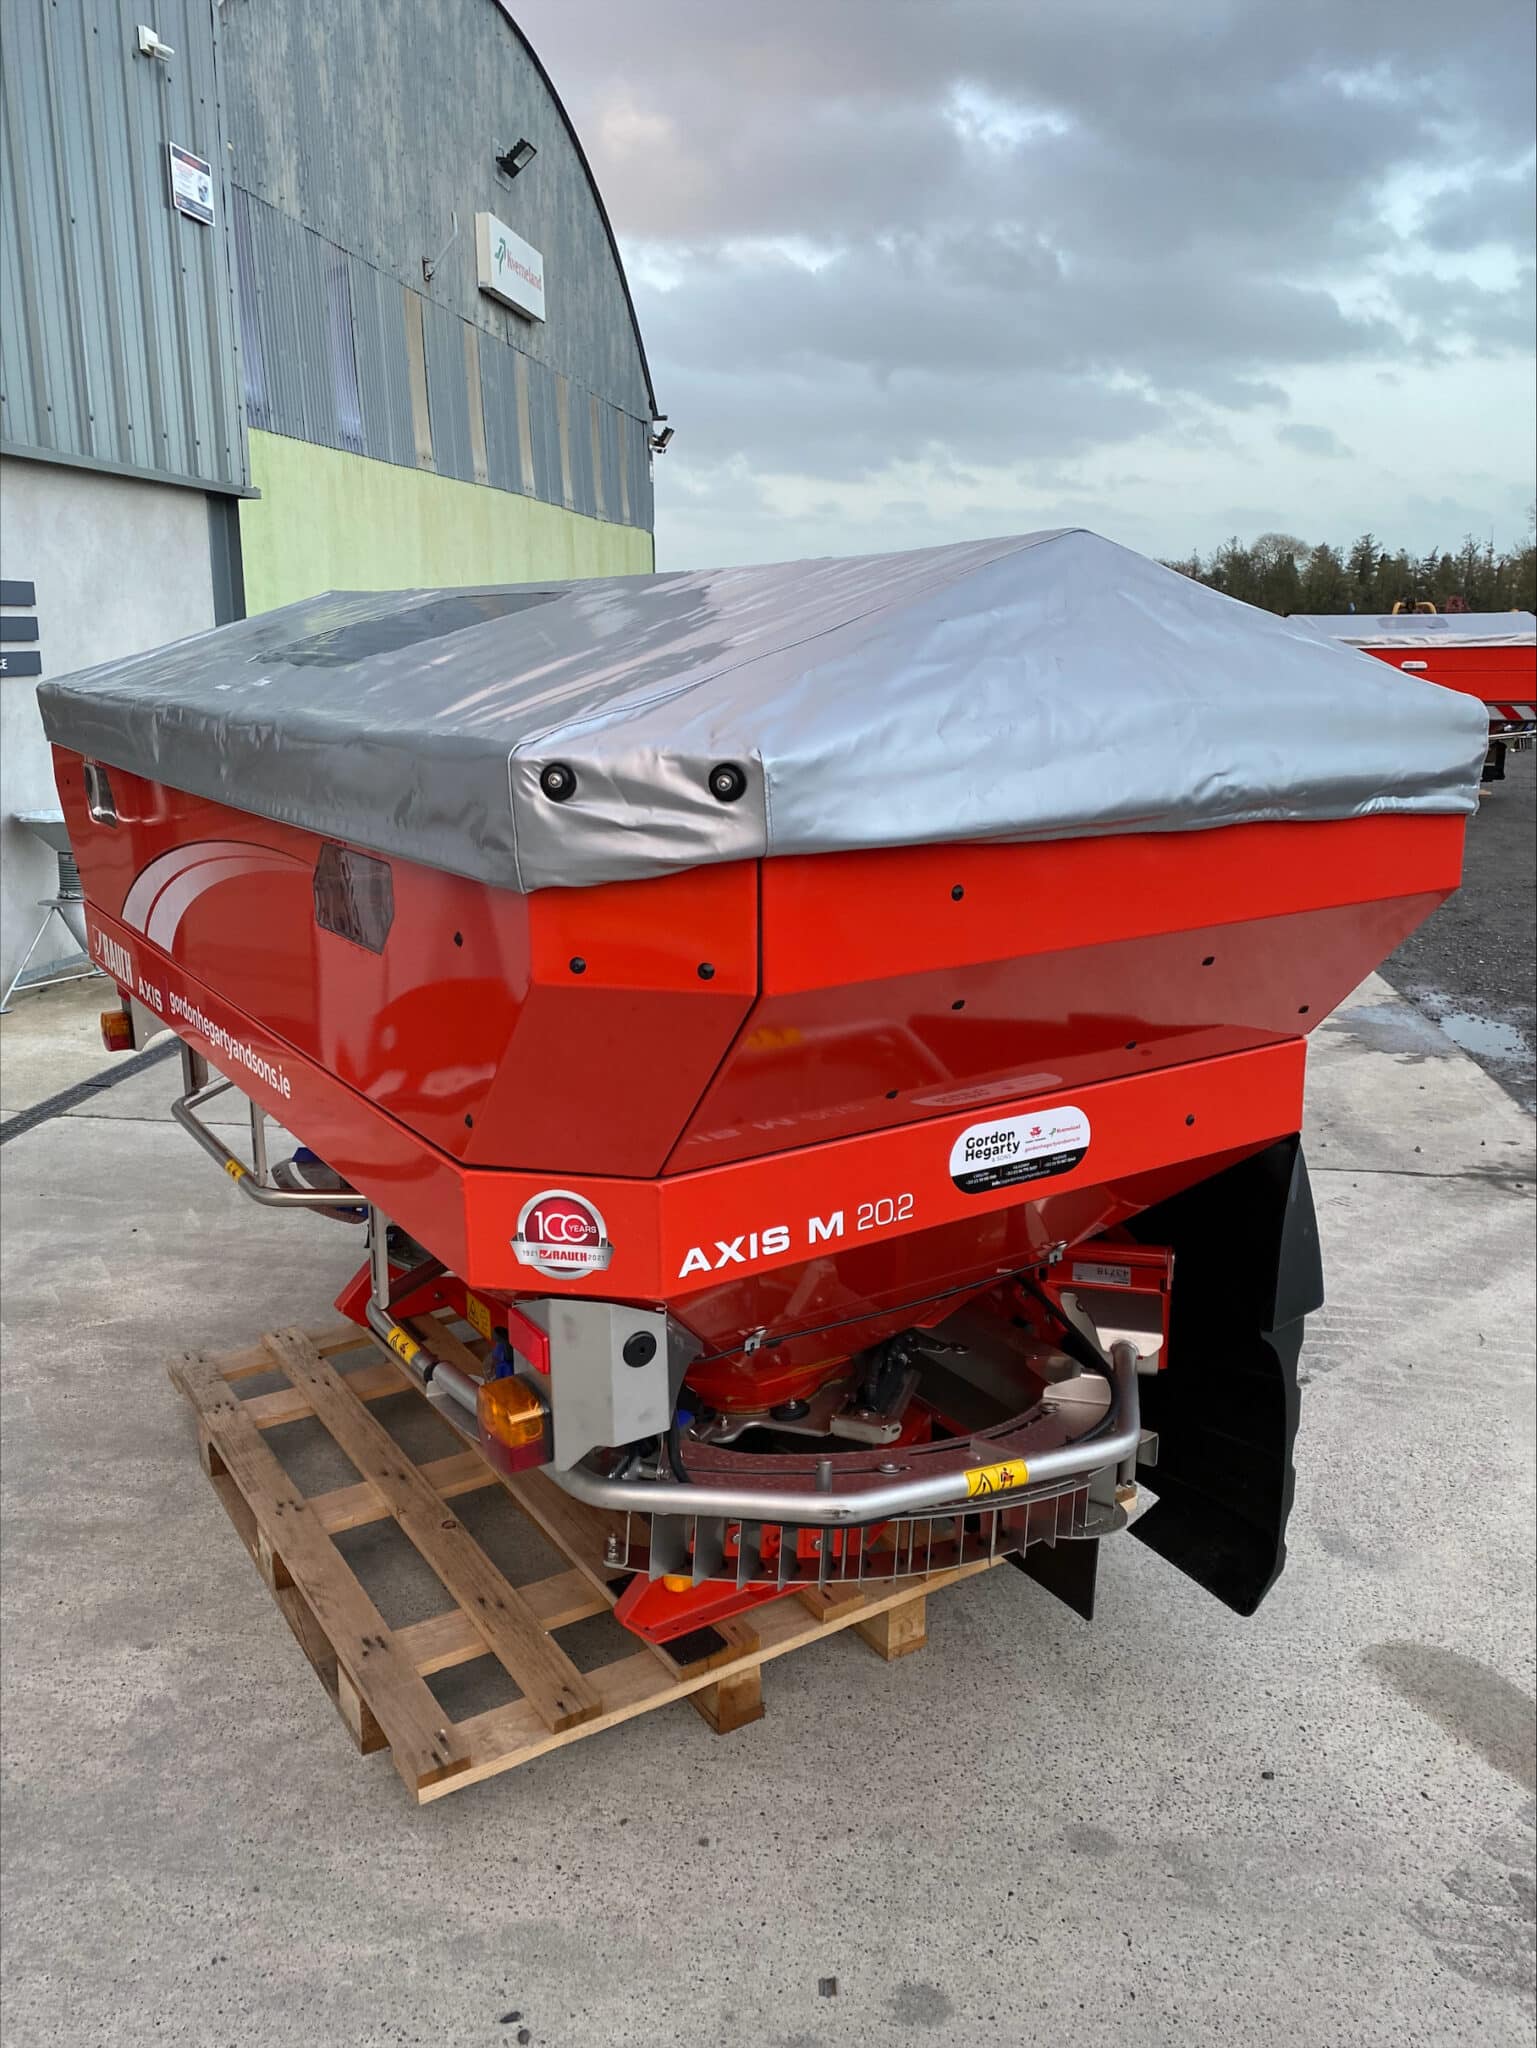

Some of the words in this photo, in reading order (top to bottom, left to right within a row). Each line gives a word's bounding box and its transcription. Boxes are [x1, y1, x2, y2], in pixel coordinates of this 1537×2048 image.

[103, 933, 134, 988] RAUCH
[138, 976, 163, 1013] AXIS
[169, 991, 291, 1099] gordonhegartyandsons.ie
[966, 1130, 1015, 1149] Gordon
[965, 1141, 1020, 1162] Hegarty
[534, 1211, 588, 1243] 100
[568, 1224, 597, 1234] YEARS
[678, 1225, 790, 1279] AXIS
[808, 1210, 844, 1244] M
[857, 1193, 914, 1231] 20.2
[552, 1250, 587, 1262] RAUCH
